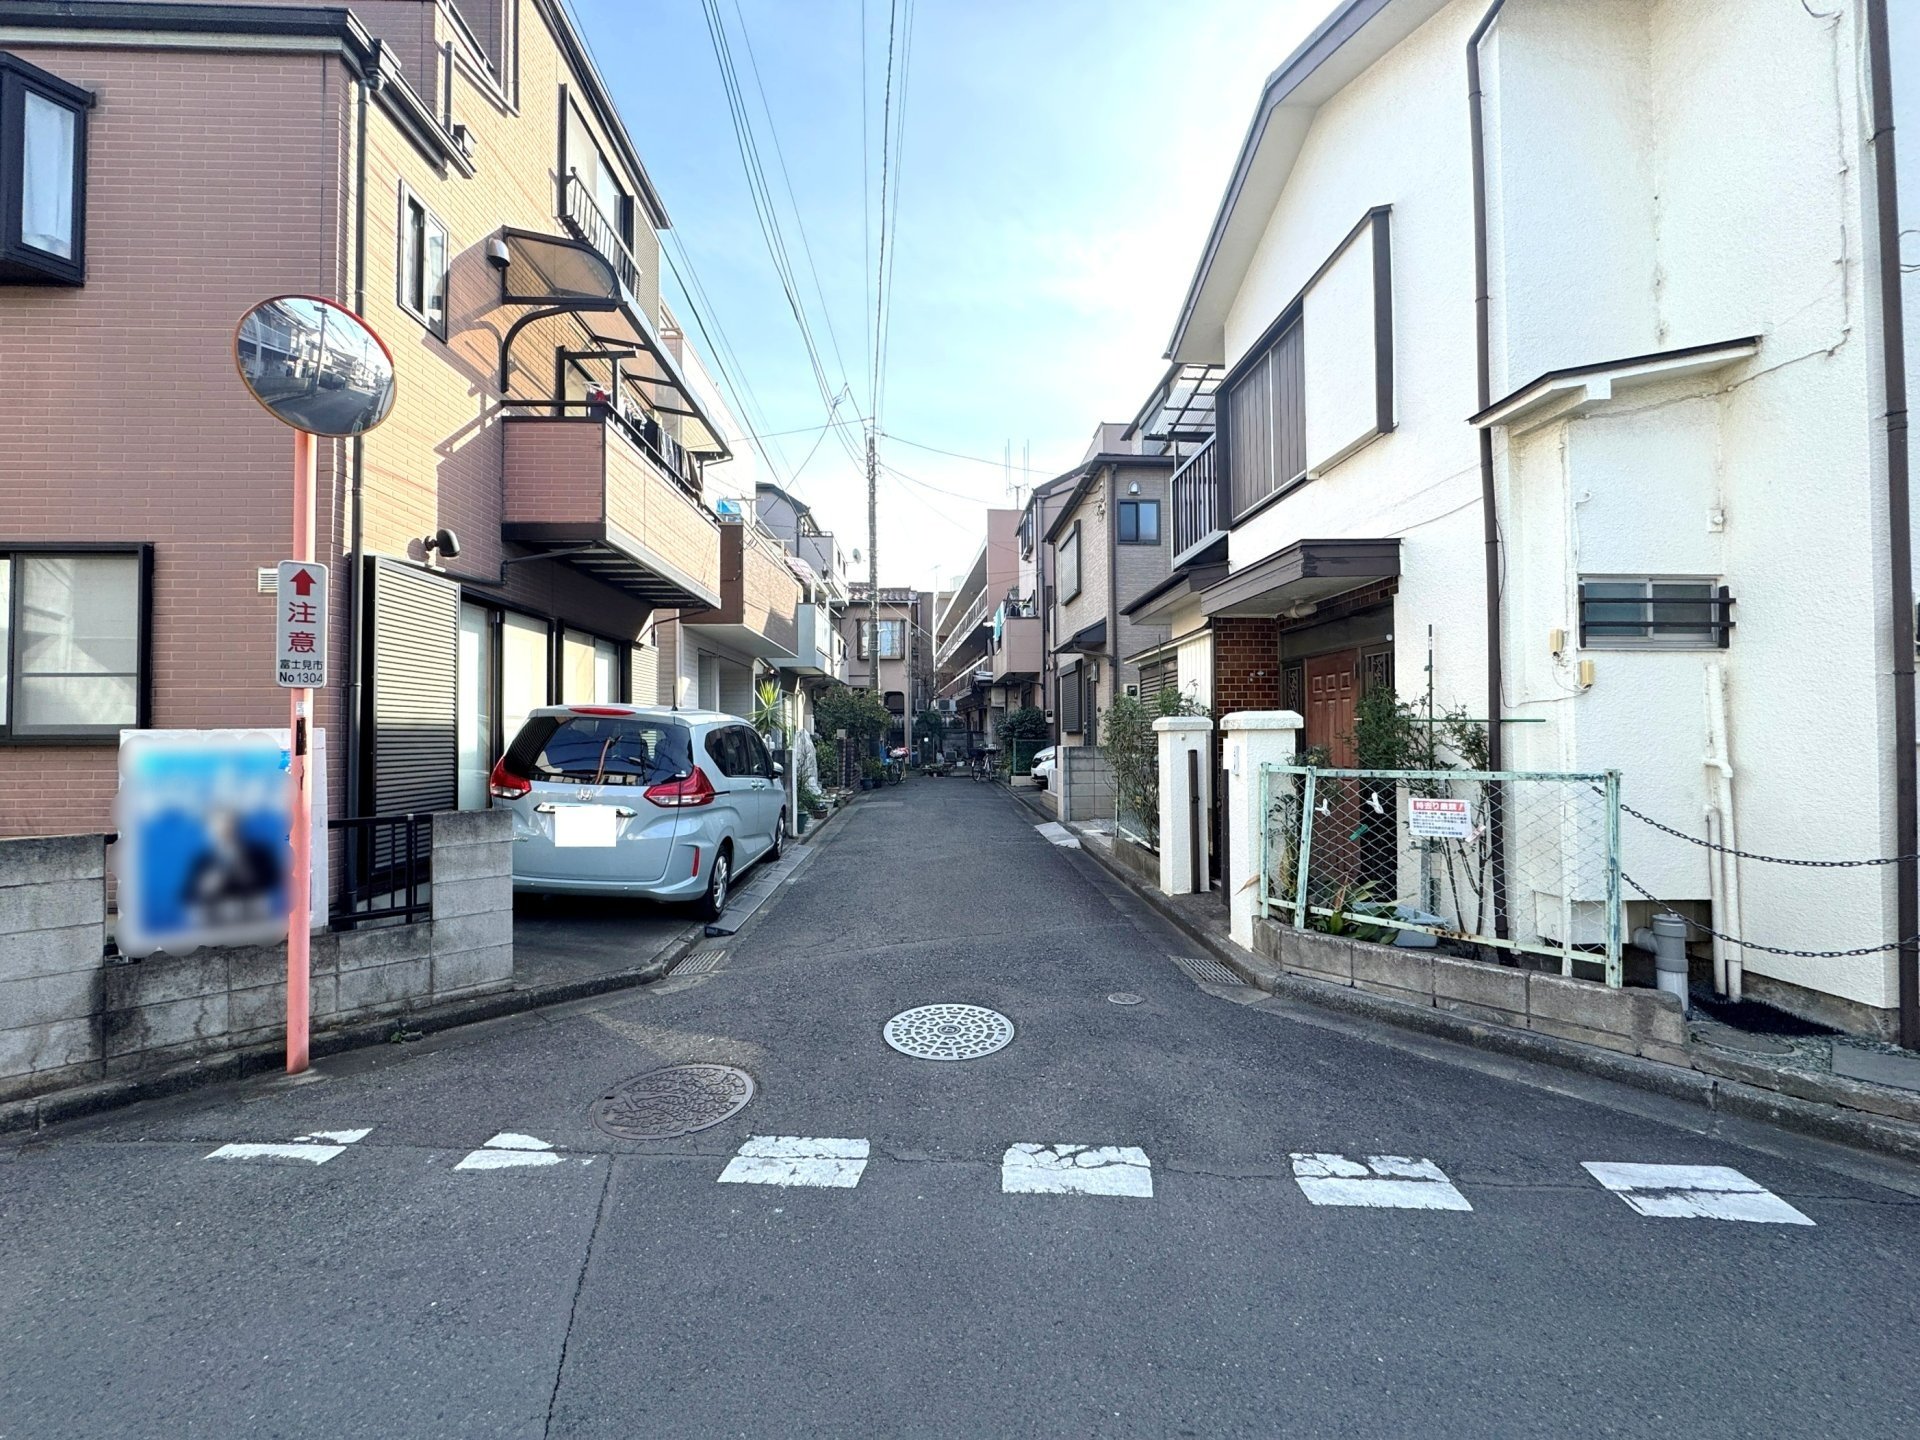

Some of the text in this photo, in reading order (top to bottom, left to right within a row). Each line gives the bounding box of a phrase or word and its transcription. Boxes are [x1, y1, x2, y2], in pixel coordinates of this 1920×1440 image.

[288, 601, 317, 653] 注意
[280, 659, 323, 671] 富士見市
[297, 672, 323, 683] 1304
